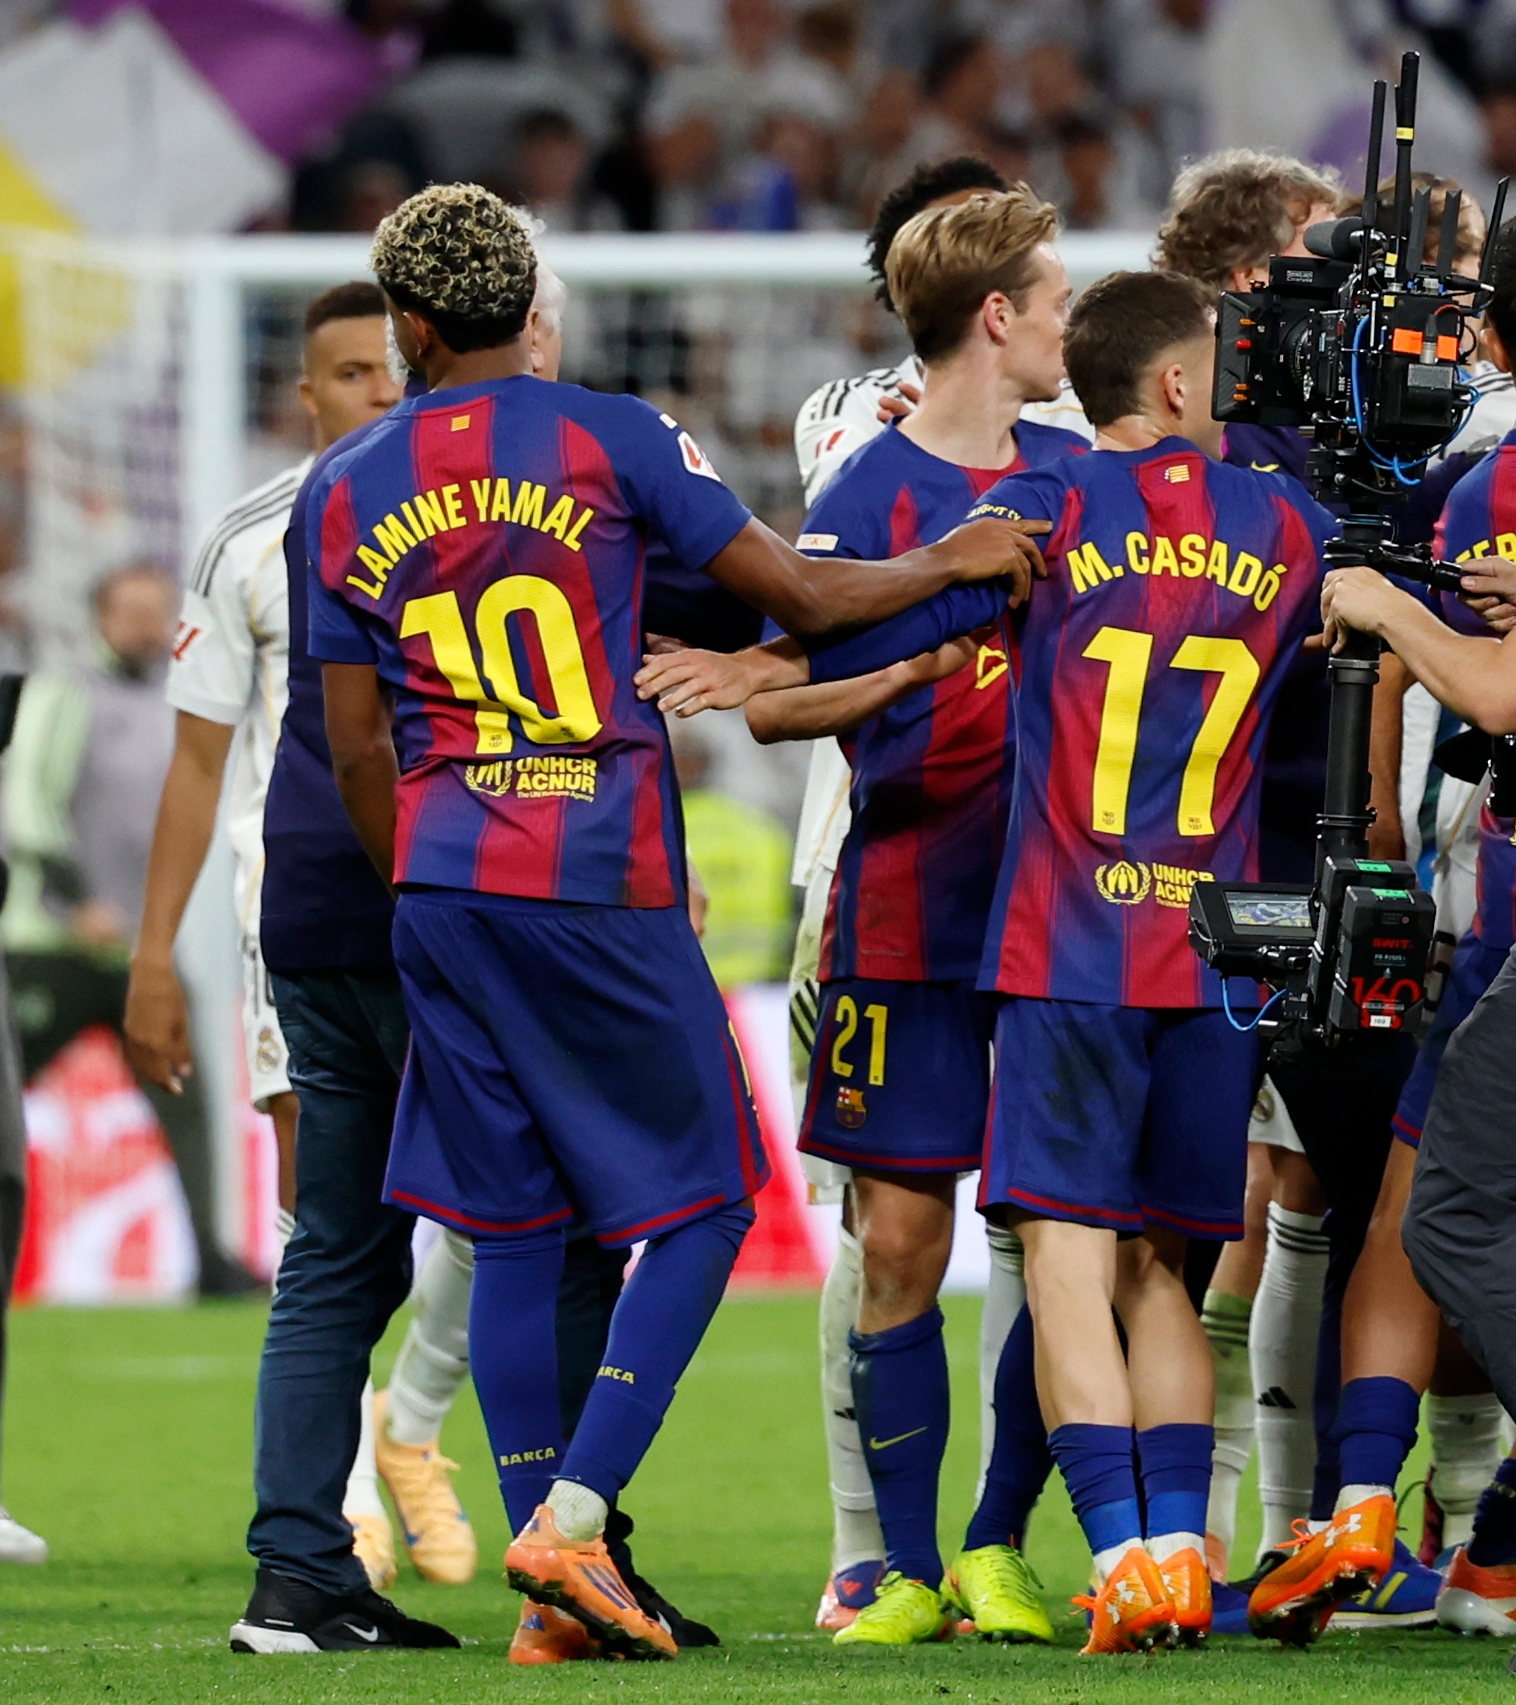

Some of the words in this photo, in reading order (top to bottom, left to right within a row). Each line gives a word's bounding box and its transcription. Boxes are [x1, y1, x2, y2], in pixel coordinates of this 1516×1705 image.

[346, 483, 467, 600] LAMINE
[470, 478, 594, 552] YAMAL
[1066, 541, 1124, 594] M.
[1126, 531, 1288, 611] CASADÓ
[400, 574, 604, 754] 10
[516, 757, 597, 776] UNHCR
[1081, 626, 1261, 836] 17
[516, 773, 595, 794] ACNUR
[831, 994, 888, 1086] 21
[500, 1447, 556, 1467] BARÇA
